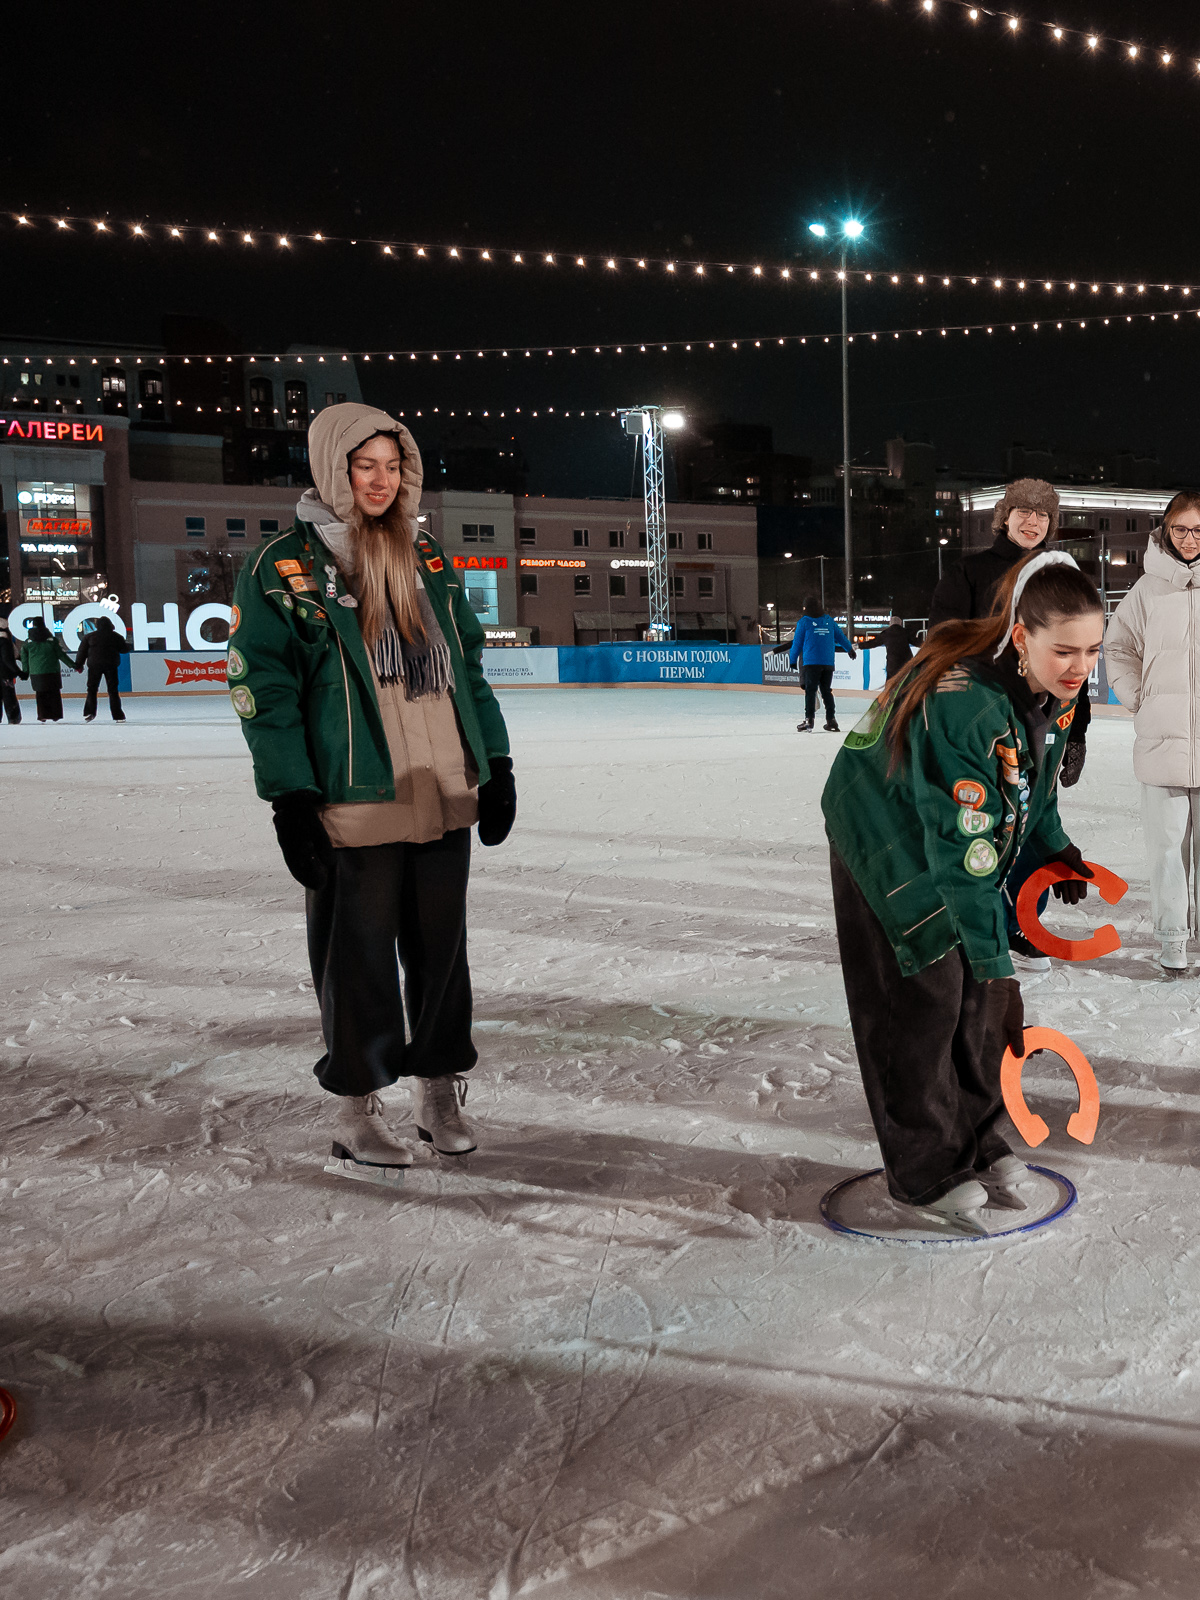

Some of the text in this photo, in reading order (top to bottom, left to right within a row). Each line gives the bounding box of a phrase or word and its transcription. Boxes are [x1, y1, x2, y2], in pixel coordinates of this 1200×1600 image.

[31, 521, 88, 531] МАГНИТ
[453, 556, 508, 569] БАНЯ
[520, 559, 586, 568] РЕМОНТ ЧАСОВ
[619, 560, 655, 568] СТОЛОТО
[622, 650, 731, 664] С НОВЫМ ГОДОМ,
[174, 666, 227, 678] Альфа Бан
[659, 666, 705, 679] ПЕРМЬ!
